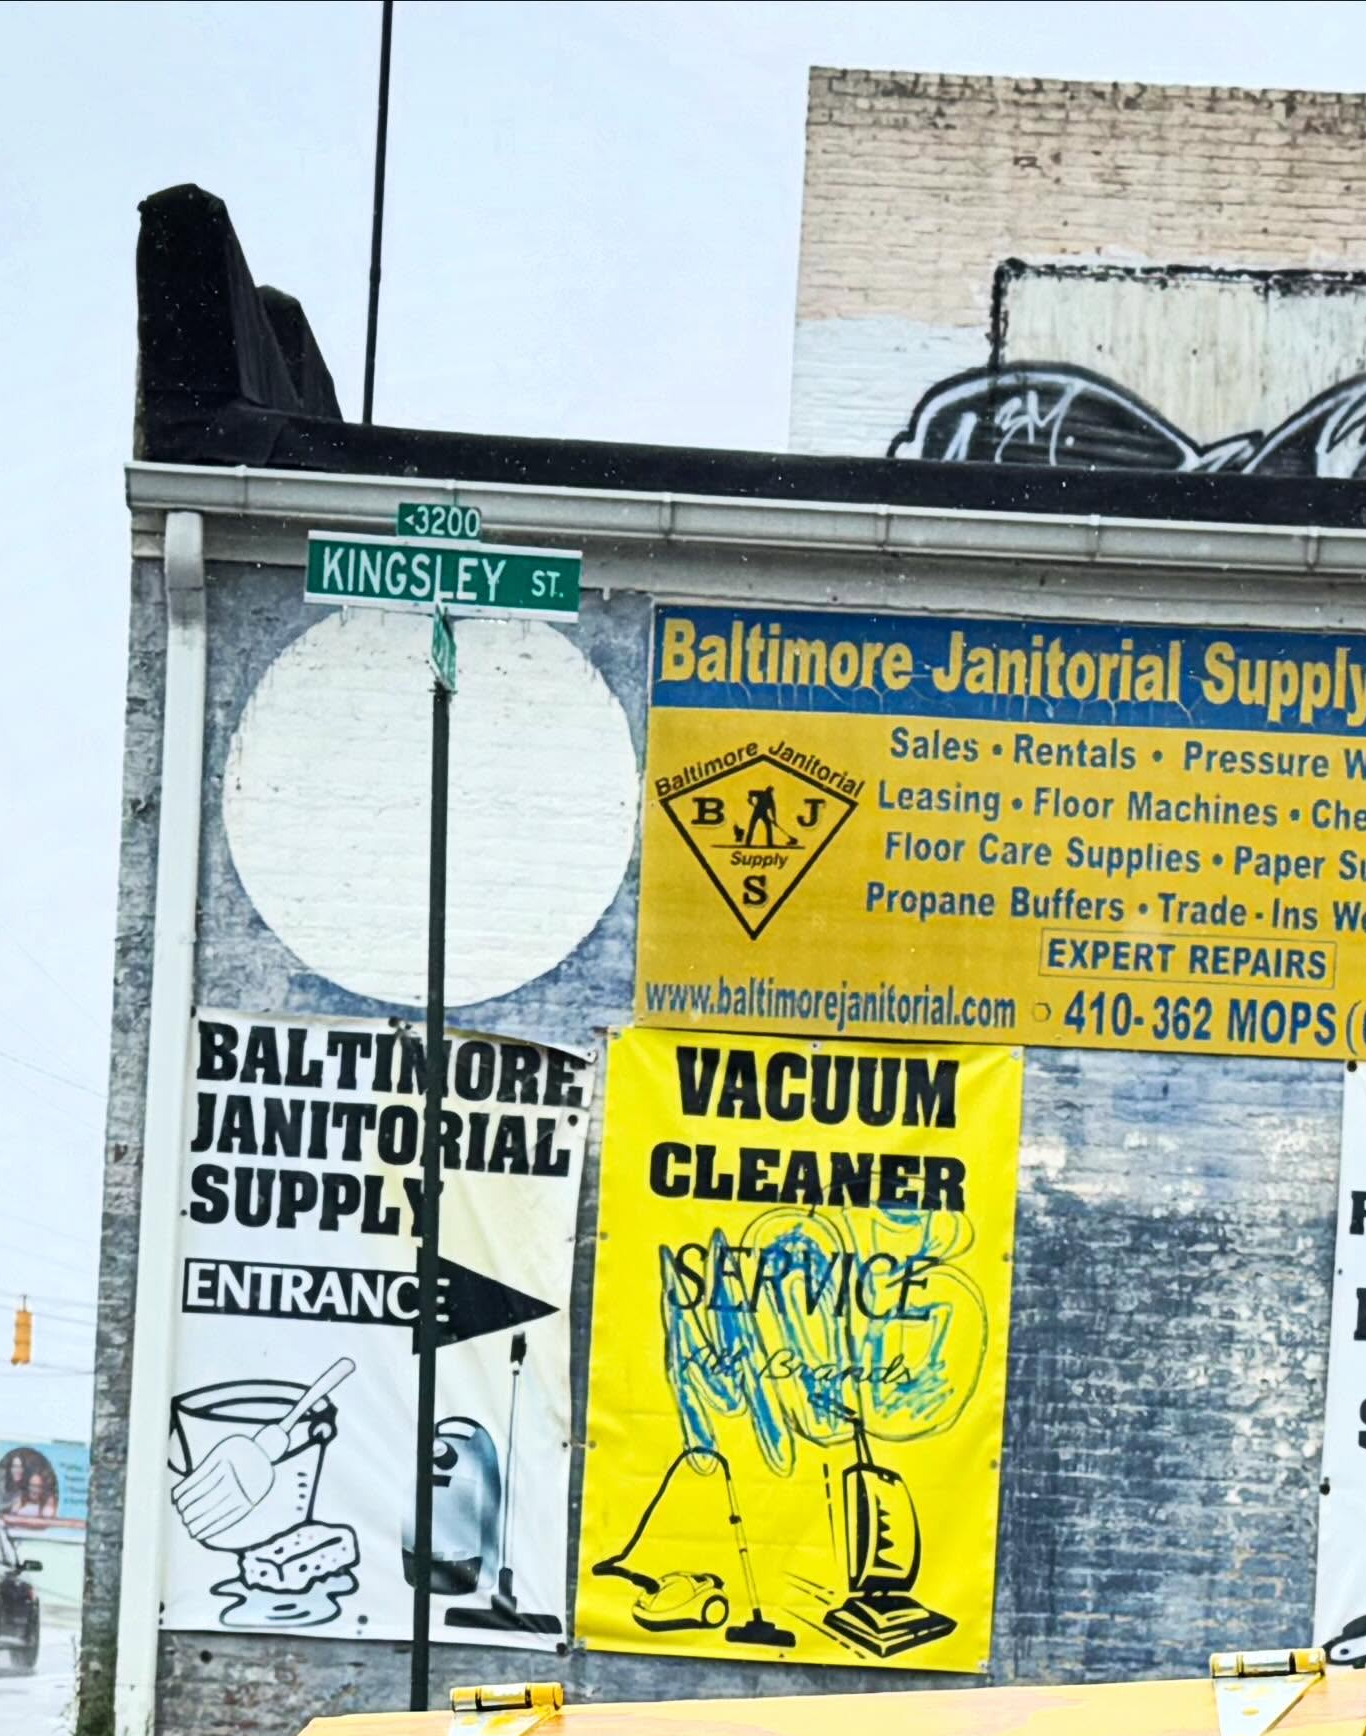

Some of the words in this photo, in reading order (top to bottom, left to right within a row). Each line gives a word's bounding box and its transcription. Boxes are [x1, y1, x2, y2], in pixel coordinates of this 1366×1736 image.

[416, 505, 481, 538] 3200
[322, 546, 507, 602] KINGSLEY
[531, 569, 564, 599] ST.
[660, 617, 913, 691] Baltimore
[932, 630, 1181, 702] Janitorial
[655, 741, 758, 798] Baltimore
[768, 740, 866, 798] Janitorial
[890, 726, 979, 762] Sales
[1014, 733, 1136, 769] Rentals
[1184, 741, 1329, 777] Pressure
[691, 797, 726, 826] B
[796, 798, 826, 828] J
[878, 779, 1000, 821] Leasing
[1034, 787, 1114, 819] Floor
[1127, 790, 1278, 826] Machines
[731, 851, 788, 870] Supply
[885, 831, 966, 862] Floor
[979, 832, 1052, 866] Care
[1066, 836, 1200, 878] Supplies
[1234, 845, 1326, 885] Paper
[743, 875, 769, 906] S
[866, 881, 995, 922] Propane
[1010, 886, 1124, 921] Buffers
[1047, 937, 1176, 973] EXPERT
[1189, 945, 1327, 980] REPAIRS
[645, 976, 1017, 1031] www.baltimorejanitorial.com
[1227, 998, 1337, 1047] MOPS
[196, 1020, 588, 1108] BALTIMORE
[676, 1045, 961, 1129] VACUUM
[191, 1092, 572, 1178] JANITORIAL
[190, 1163, 444, 1238] SUPPLY
[649, 1141, 966, 1212] CLEANER
[667, 1243, 940, 1322] SERVICE
[759, 1347, 915, 1384] Brands
